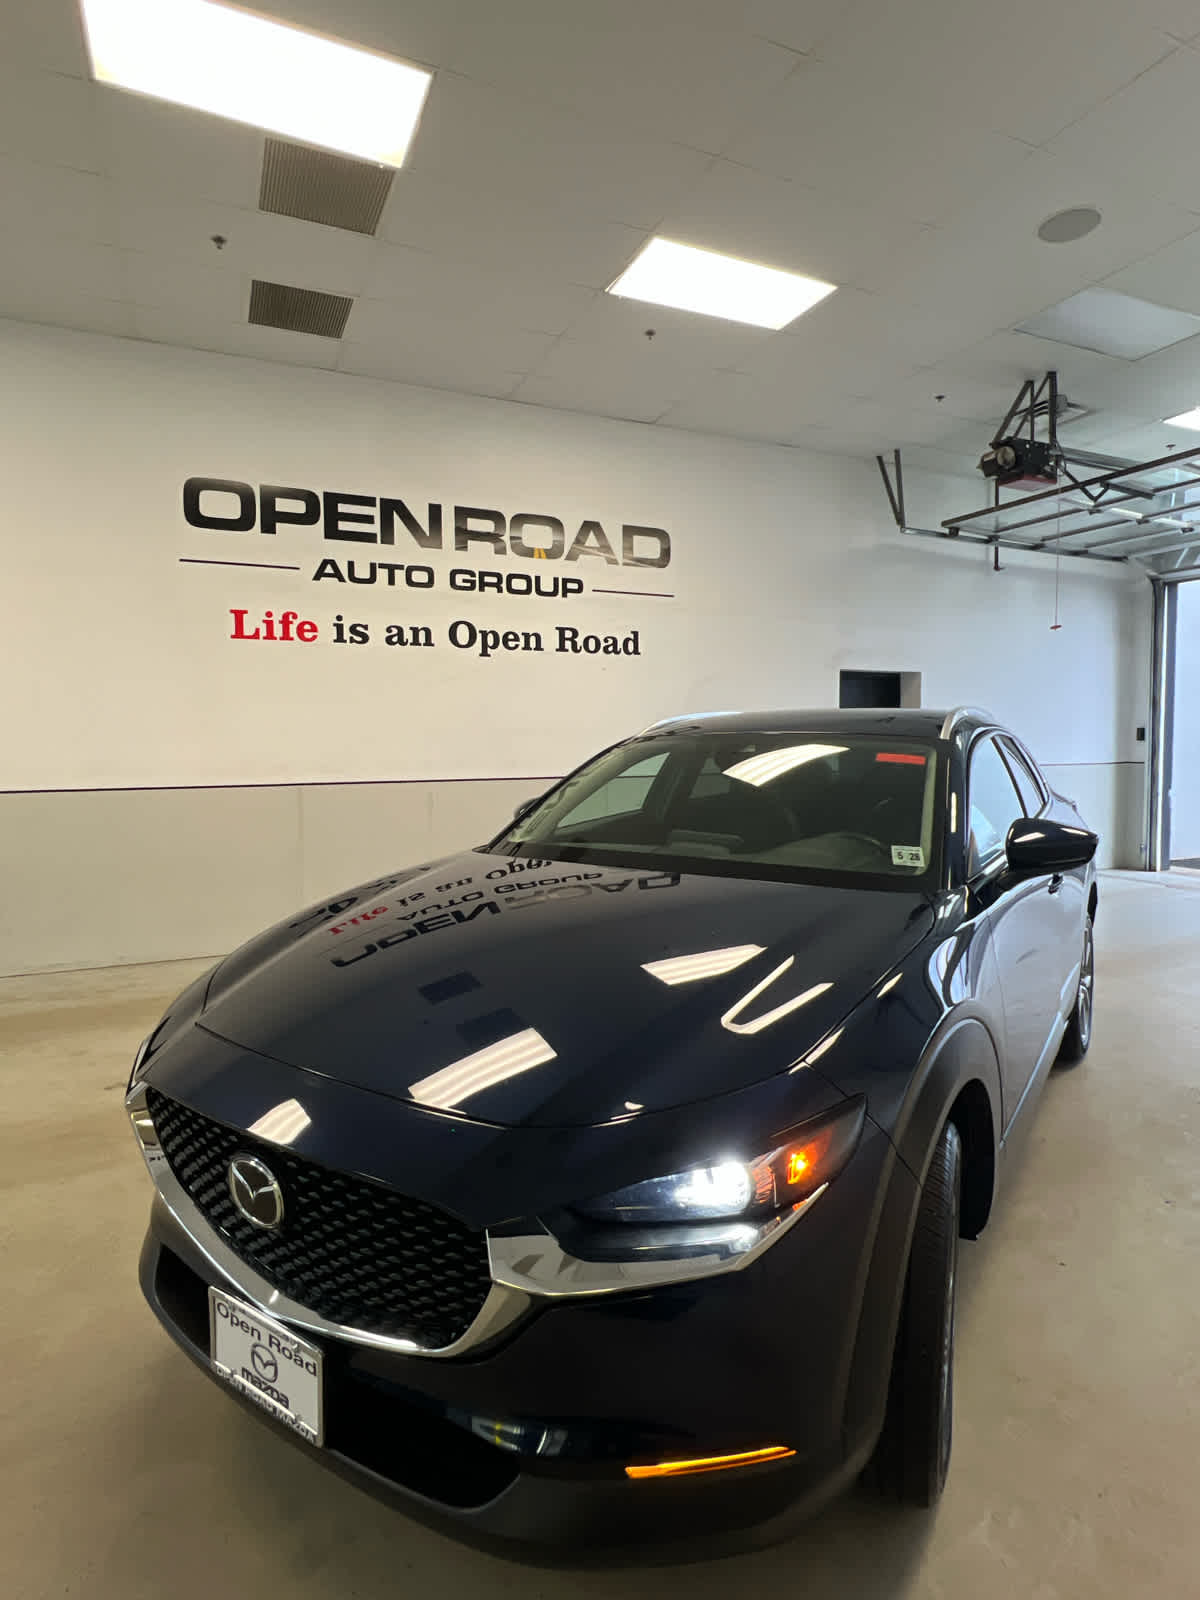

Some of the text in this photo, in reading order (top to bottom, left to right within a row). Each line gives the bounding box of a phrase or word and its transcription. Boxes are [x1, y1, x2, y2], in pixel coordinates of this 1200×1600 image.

[183, 476, 672, 569] OPEN ROAD
[312, 558, 584, 598] AUTO GROUP
[229, 609, 641, 657] Life is an Open Road
[217, 1302, 317, 1377] Open Road
